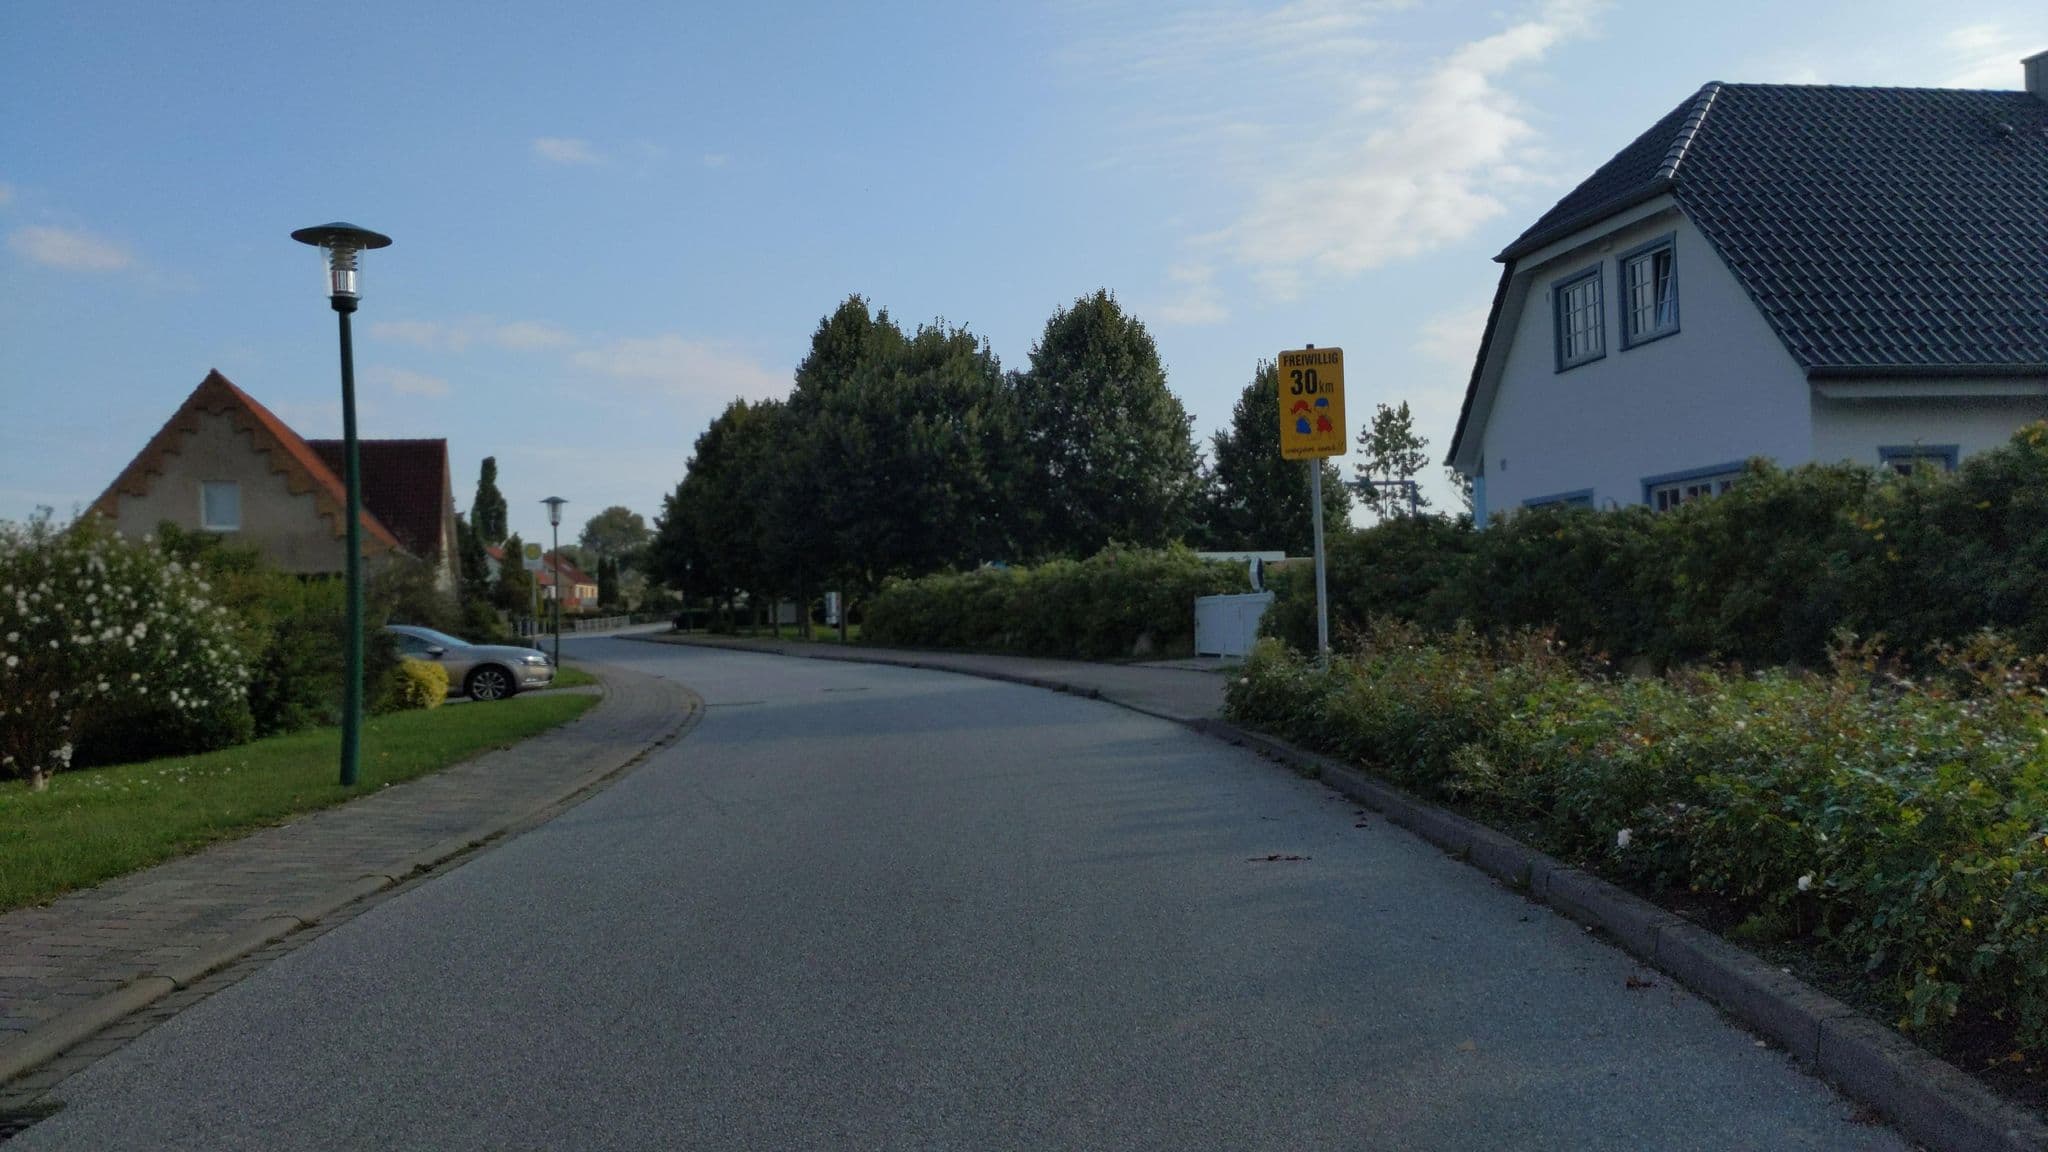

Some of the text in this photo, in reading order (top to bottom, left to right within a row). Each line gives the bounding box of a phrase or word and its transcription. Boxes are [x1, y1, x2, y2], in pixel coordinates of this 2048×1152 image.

[1283, 352, 1338, 367] FREIWILLIG
[1290, 368, 1334, 395] 30 km
